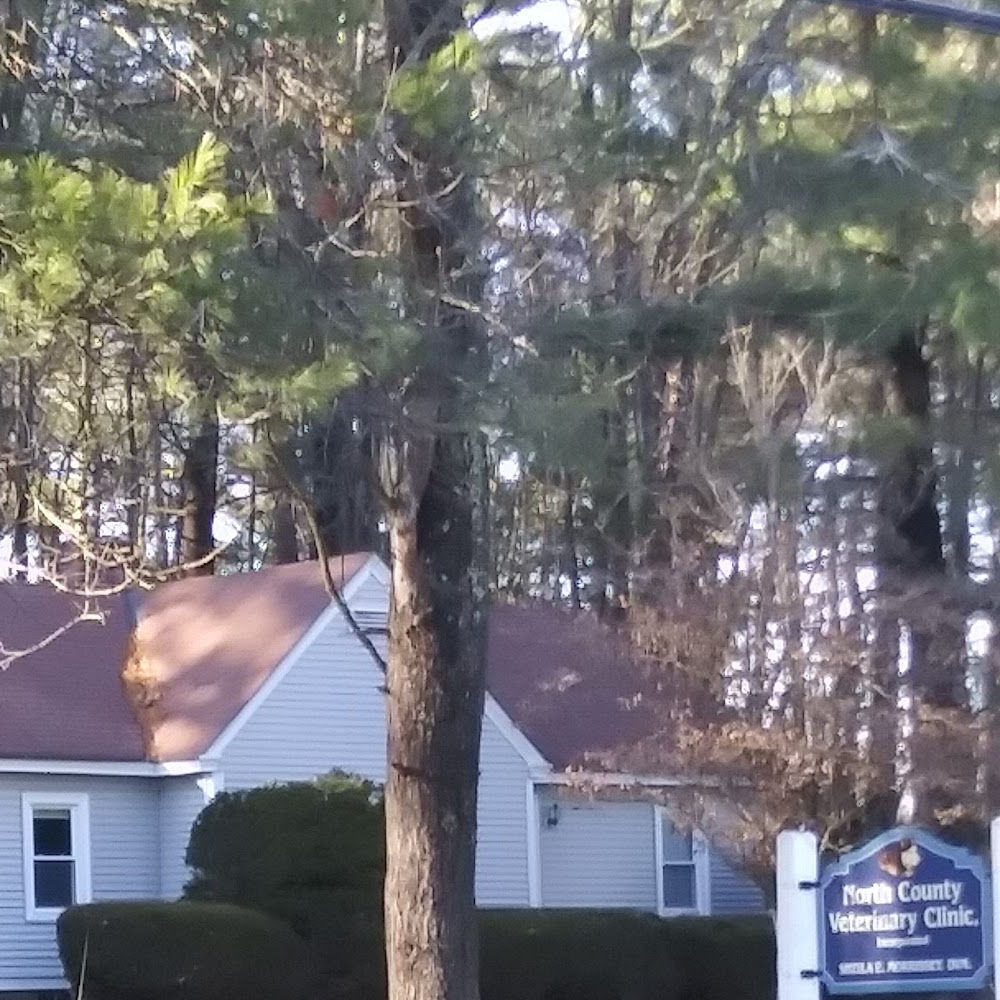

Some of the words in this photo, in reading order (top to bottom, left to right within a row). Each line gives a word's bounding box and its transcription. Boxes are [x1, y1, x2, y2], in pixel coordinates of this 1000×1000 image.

[842, 883, 893, 906] North
[898, 879, 963, 905] County
[828, 910, 917, 934] Veterinary
